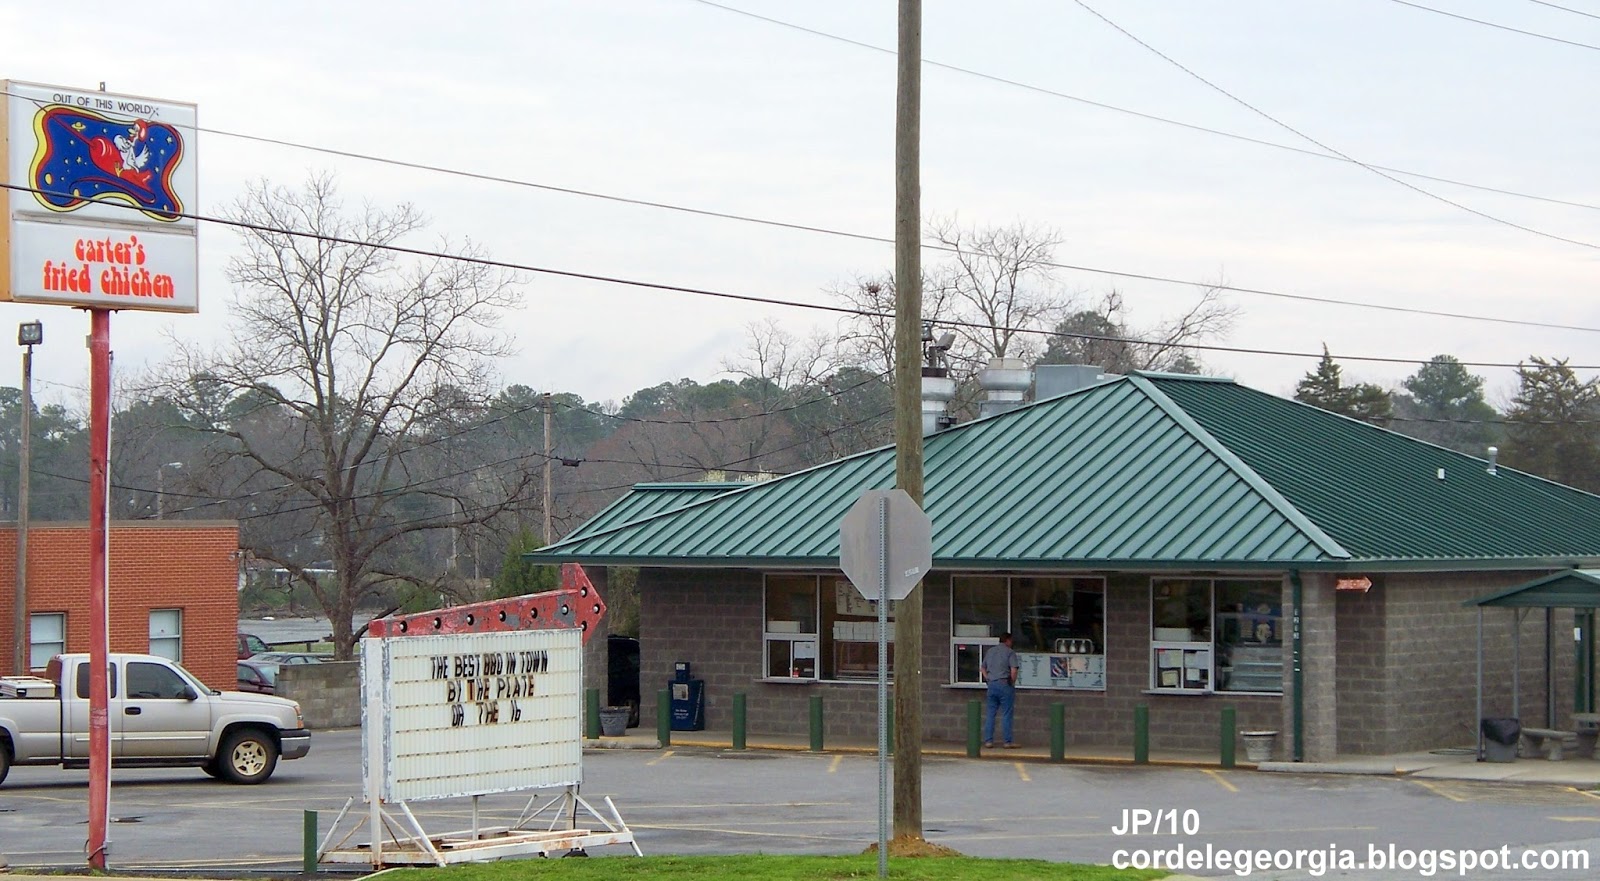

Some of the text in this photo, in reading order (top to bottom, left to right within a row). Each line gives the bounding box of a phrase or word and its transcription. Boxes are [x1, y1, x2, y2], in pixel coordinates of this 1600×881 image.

[53, 93, 72, 104] OUT
[77, 96, 90, 106] OF
[95, 98, 113, 110] THIS
[75, 235, 146, 266] carter's
[44, 260, 174, 298] fried chicken
[430, 656, 448, 679] THE
[454, 654, 480, 677] BEST
[506, 652, 517, 675] IN
[520, 650, 548, 674] TOWN
[447, 675, 535, 702] BY THE PLATE
[476, 701, 499, 724] THE
